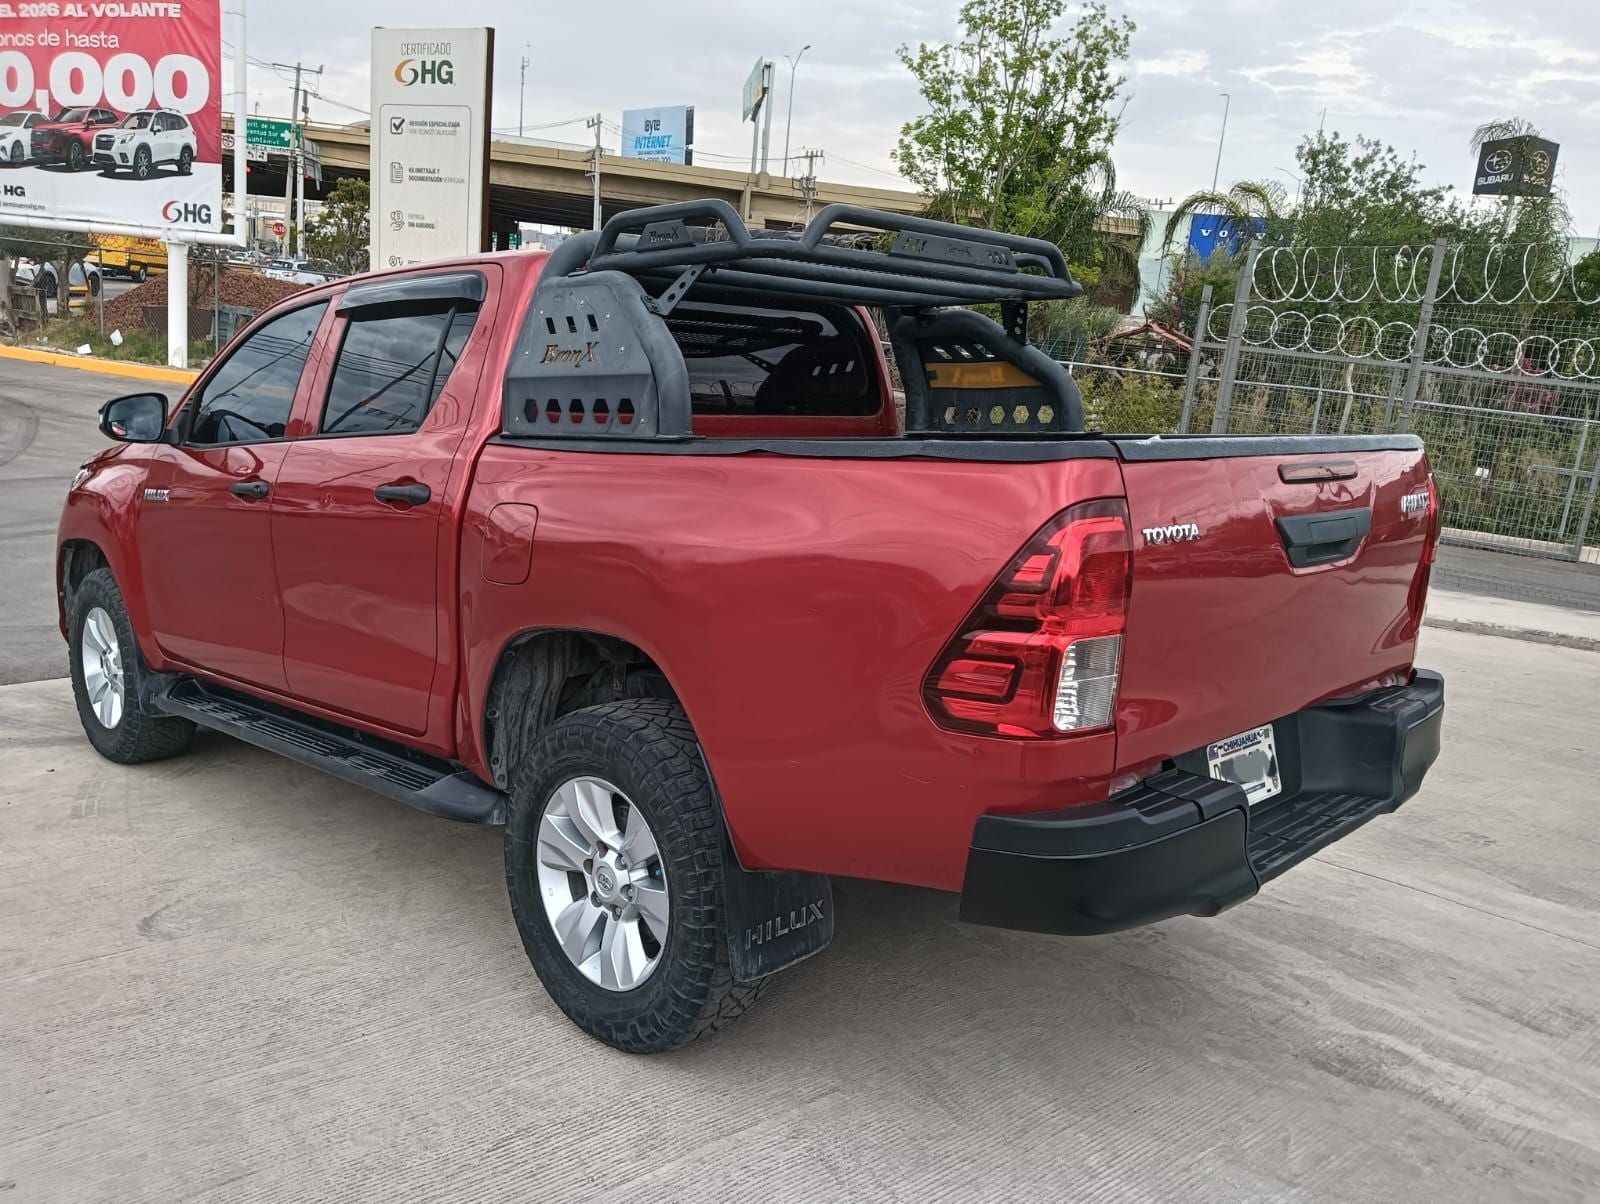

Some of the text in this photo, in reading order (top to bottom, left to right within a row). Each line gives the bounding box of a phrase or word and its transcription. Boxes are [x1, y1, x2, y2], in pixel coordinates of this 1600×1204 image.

[19, 3, 60, 18] 2026
[63, 3, 88, 17] AL
[91, 3, 181, 18] VOLANTE
[38, 28, 60, 47] de
[65, 29, 119, 48] hasta
[400, 42, 452, 56] CERTIFICADO
[421, 60, 454, 85] HG
[634, 135, 672, 149] INTERNET
[1477, 173, 1514, 186] SUBARU
[3, 185, 26, 198] HG
[183, 202, 212, 225] HG
[273, 225, 285, 233] ALTO
[1142, 523, 1200, 546] TOYOTA
[1223, 732, 1258, 752] CHIHUAHUA
[745, 899, 825, 951] HILUX
